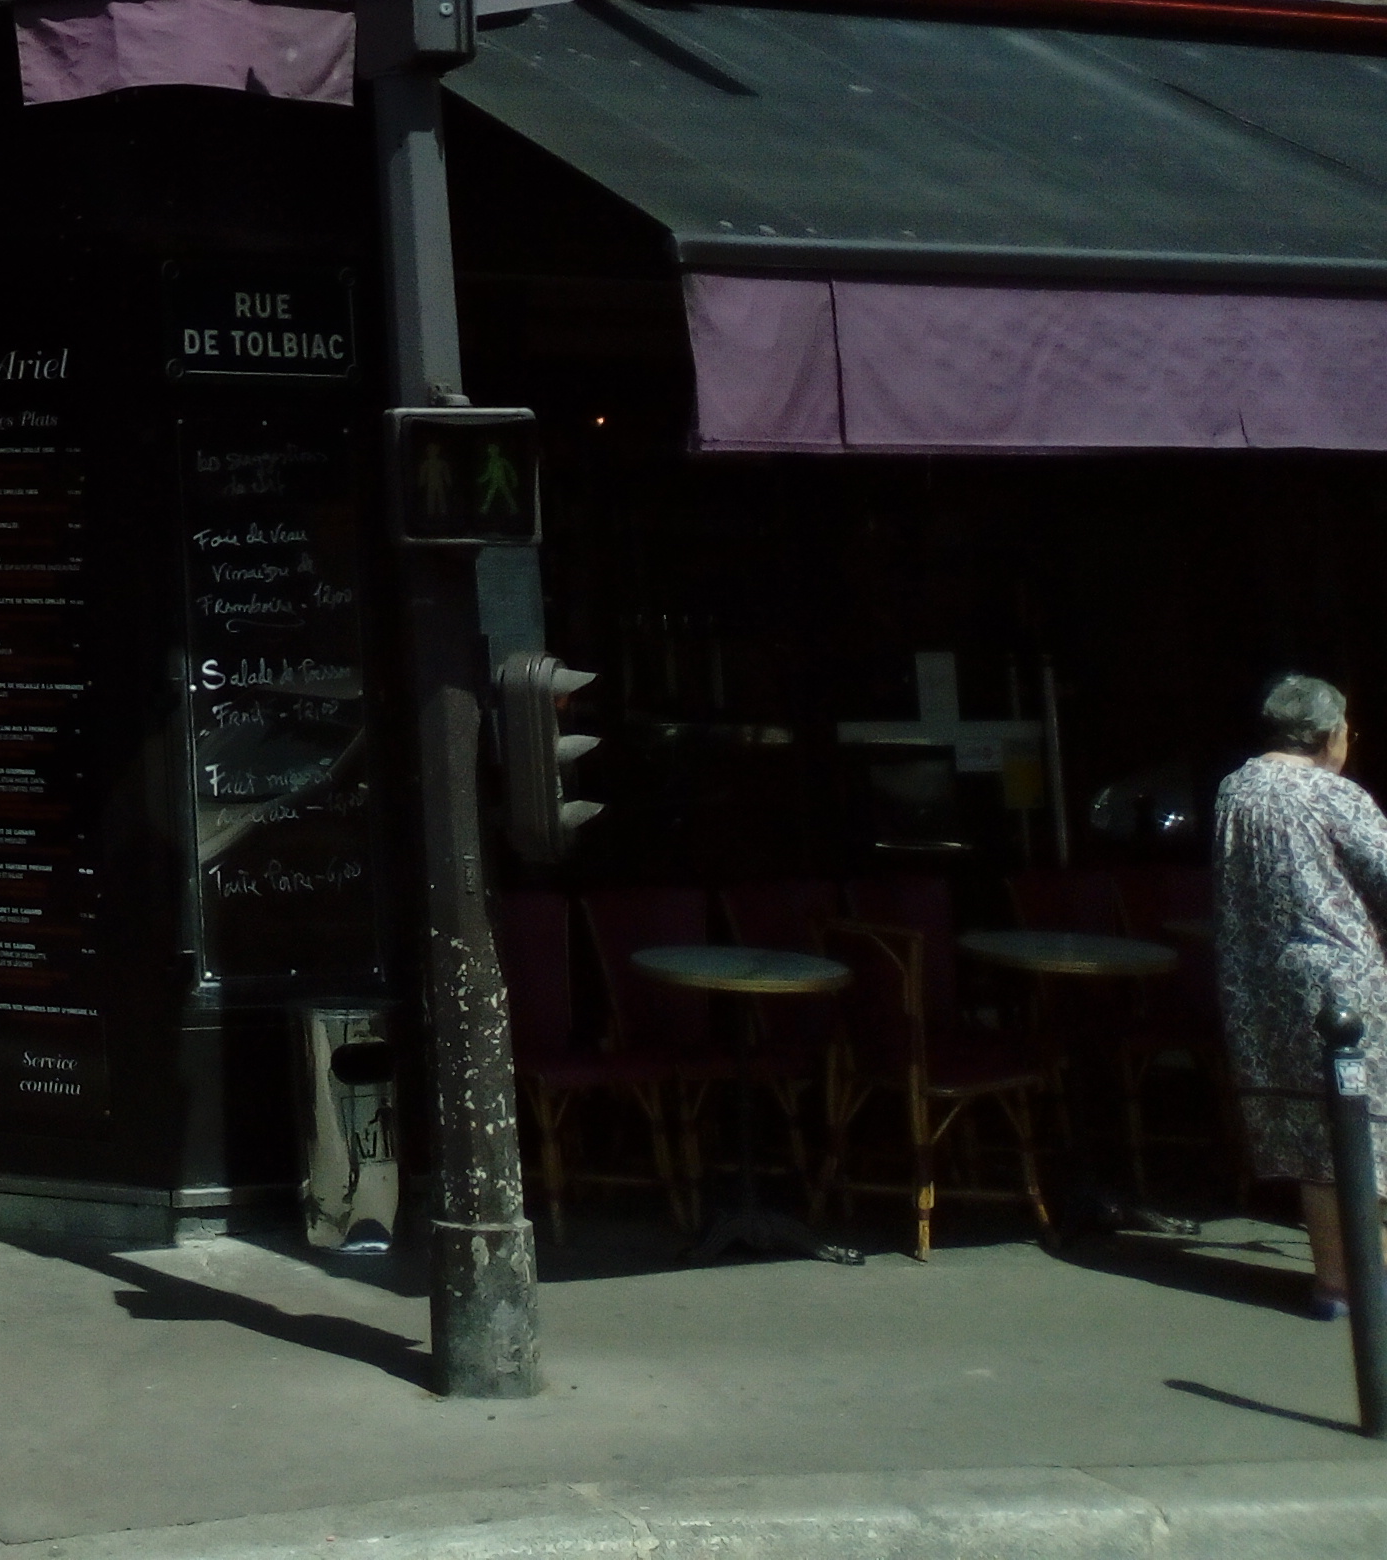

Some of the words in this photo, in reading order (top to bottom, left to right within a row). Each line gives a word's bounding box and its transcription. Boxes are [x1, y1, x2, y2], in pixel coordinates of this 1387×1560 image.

[235, 291, 292, 320] RUE
[184, 328, 220, 356] DE
[231, 330, 345, 360] TOLBIAC
[20, 410, 59, 428] Plats
[202, 657, 273, 689] Salade
[22, 1050, 78, 1072] Service
[18, 1077, 82, 1096] continu
